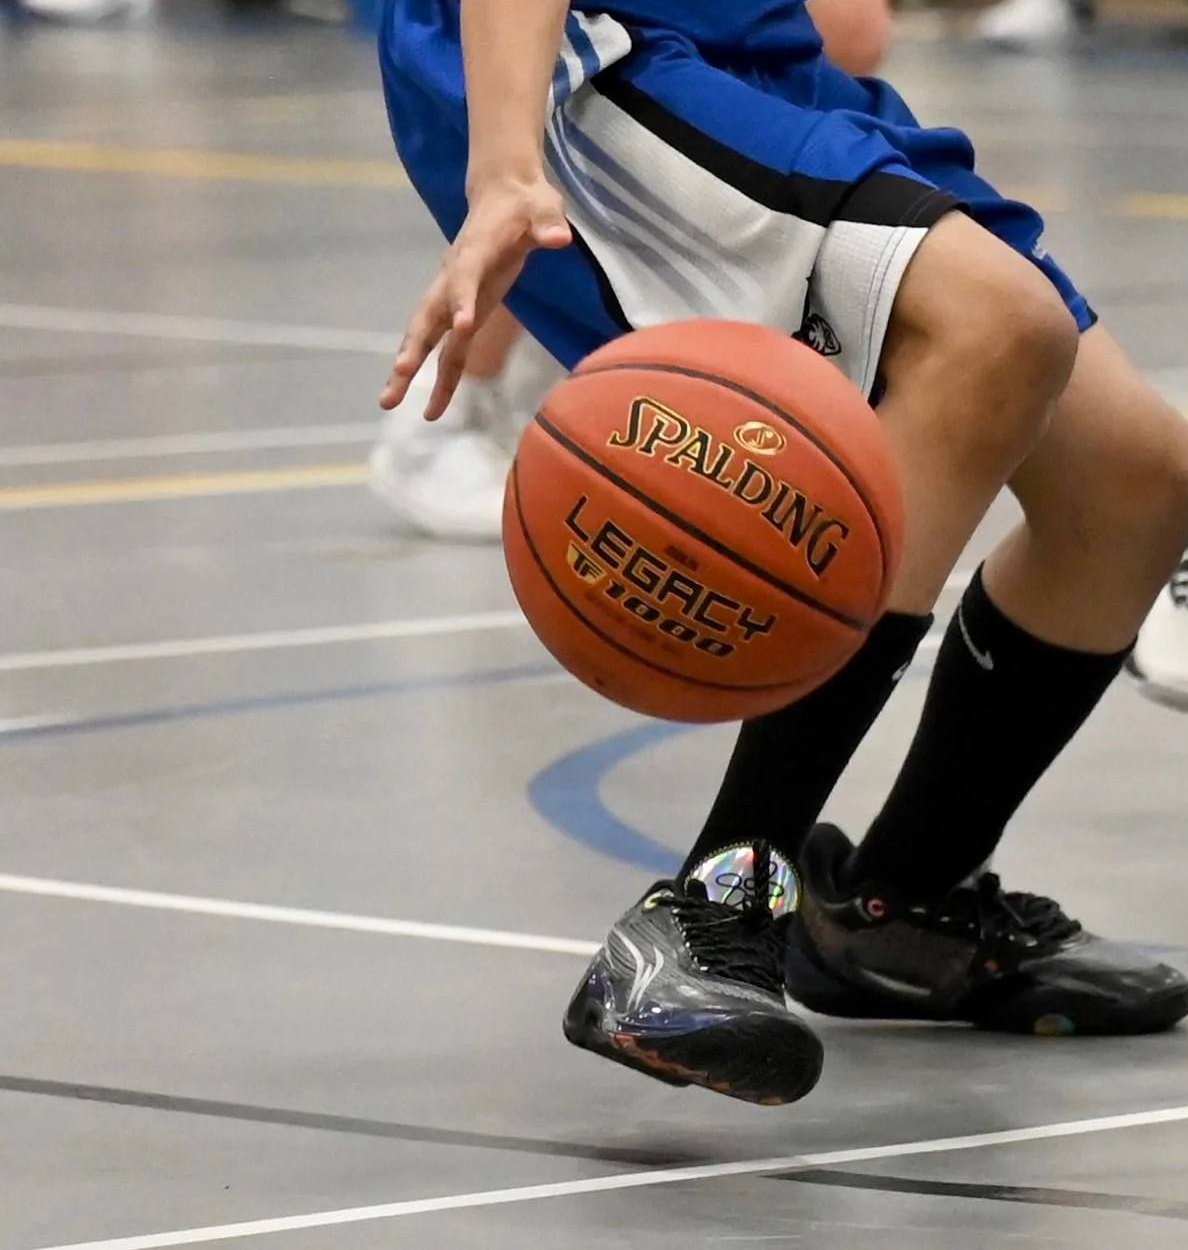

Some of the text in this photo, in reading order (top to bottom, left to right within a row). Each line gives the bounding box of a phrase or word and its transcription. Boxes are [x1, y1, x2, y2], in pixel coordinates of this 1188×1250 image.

[606, 395, 852, 579] SPALDING
[564, 493, 779, 643] LEGACY
[568, 541, 606, 583] TF
[603, 578, 736, 659] 1000
